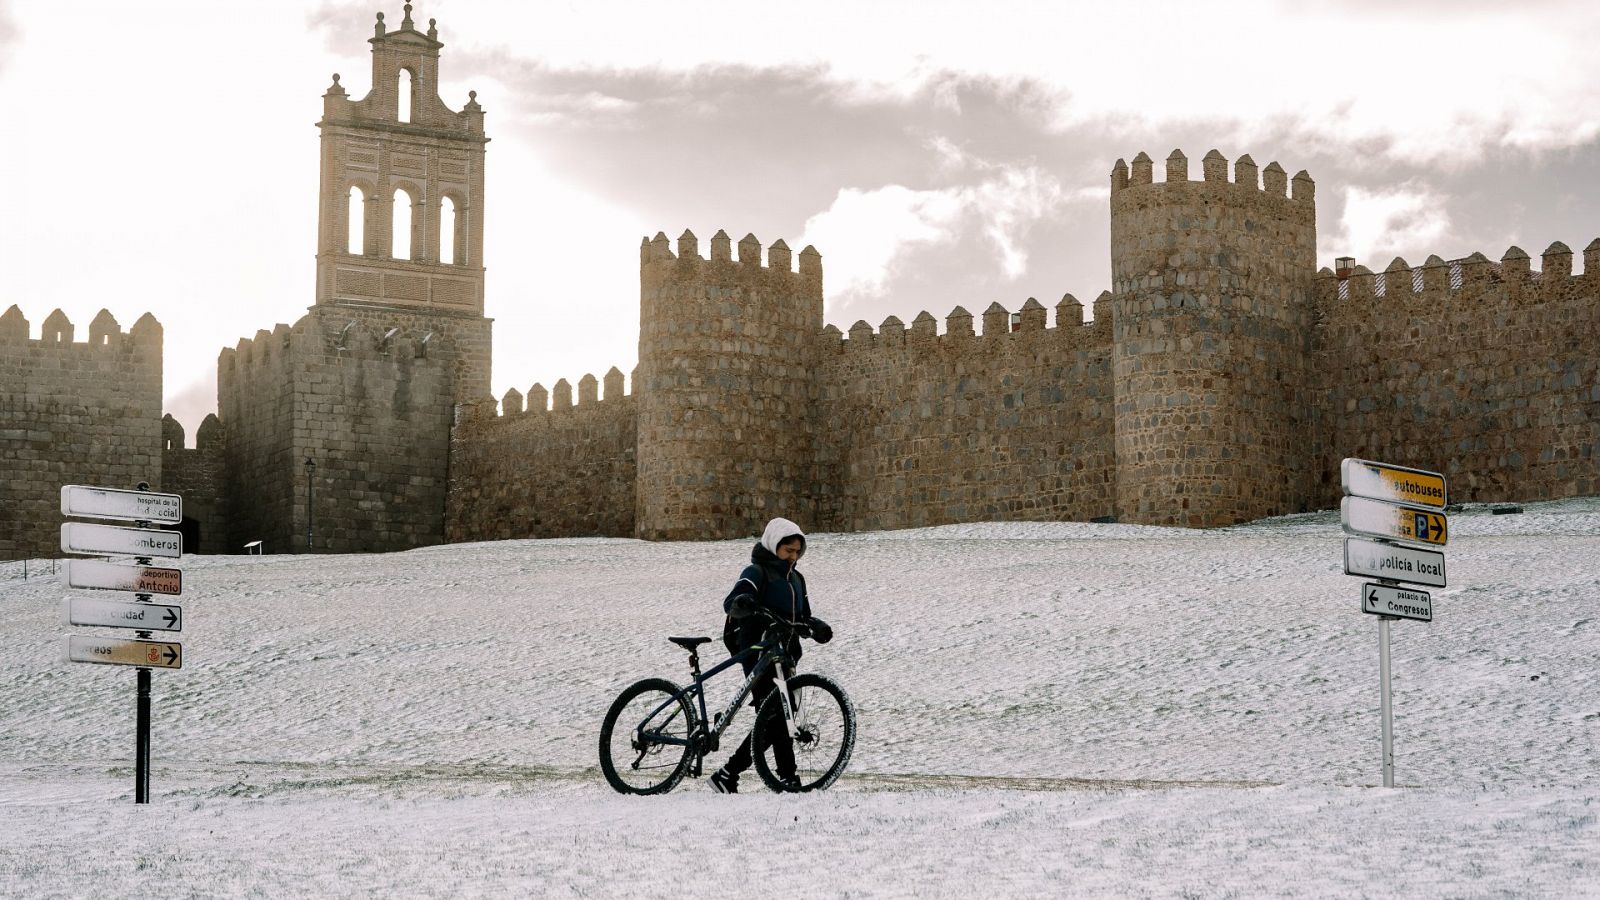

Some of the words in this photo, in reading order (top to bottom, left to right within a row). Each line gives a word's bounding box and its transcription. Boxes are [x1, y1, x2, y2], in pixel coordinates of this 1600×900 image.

[137, 497, 162, 506] hospital
[154, 507, 178, 518] ocial
[131, 536, 178, 550] omberos
[1379, 556, 1412, 571] policía
[1416, 559, 1442, 577] local
[138, 579, 178, 592] Antonio
[1397, 592, 1419, 602] palacio
[1420, 594, 1428, 602] de
[1387, 600, 1430, 616] Congresos
[110, 610, 145, 620] cudad
[713, 672, 755, 732] ROCKRIDER
